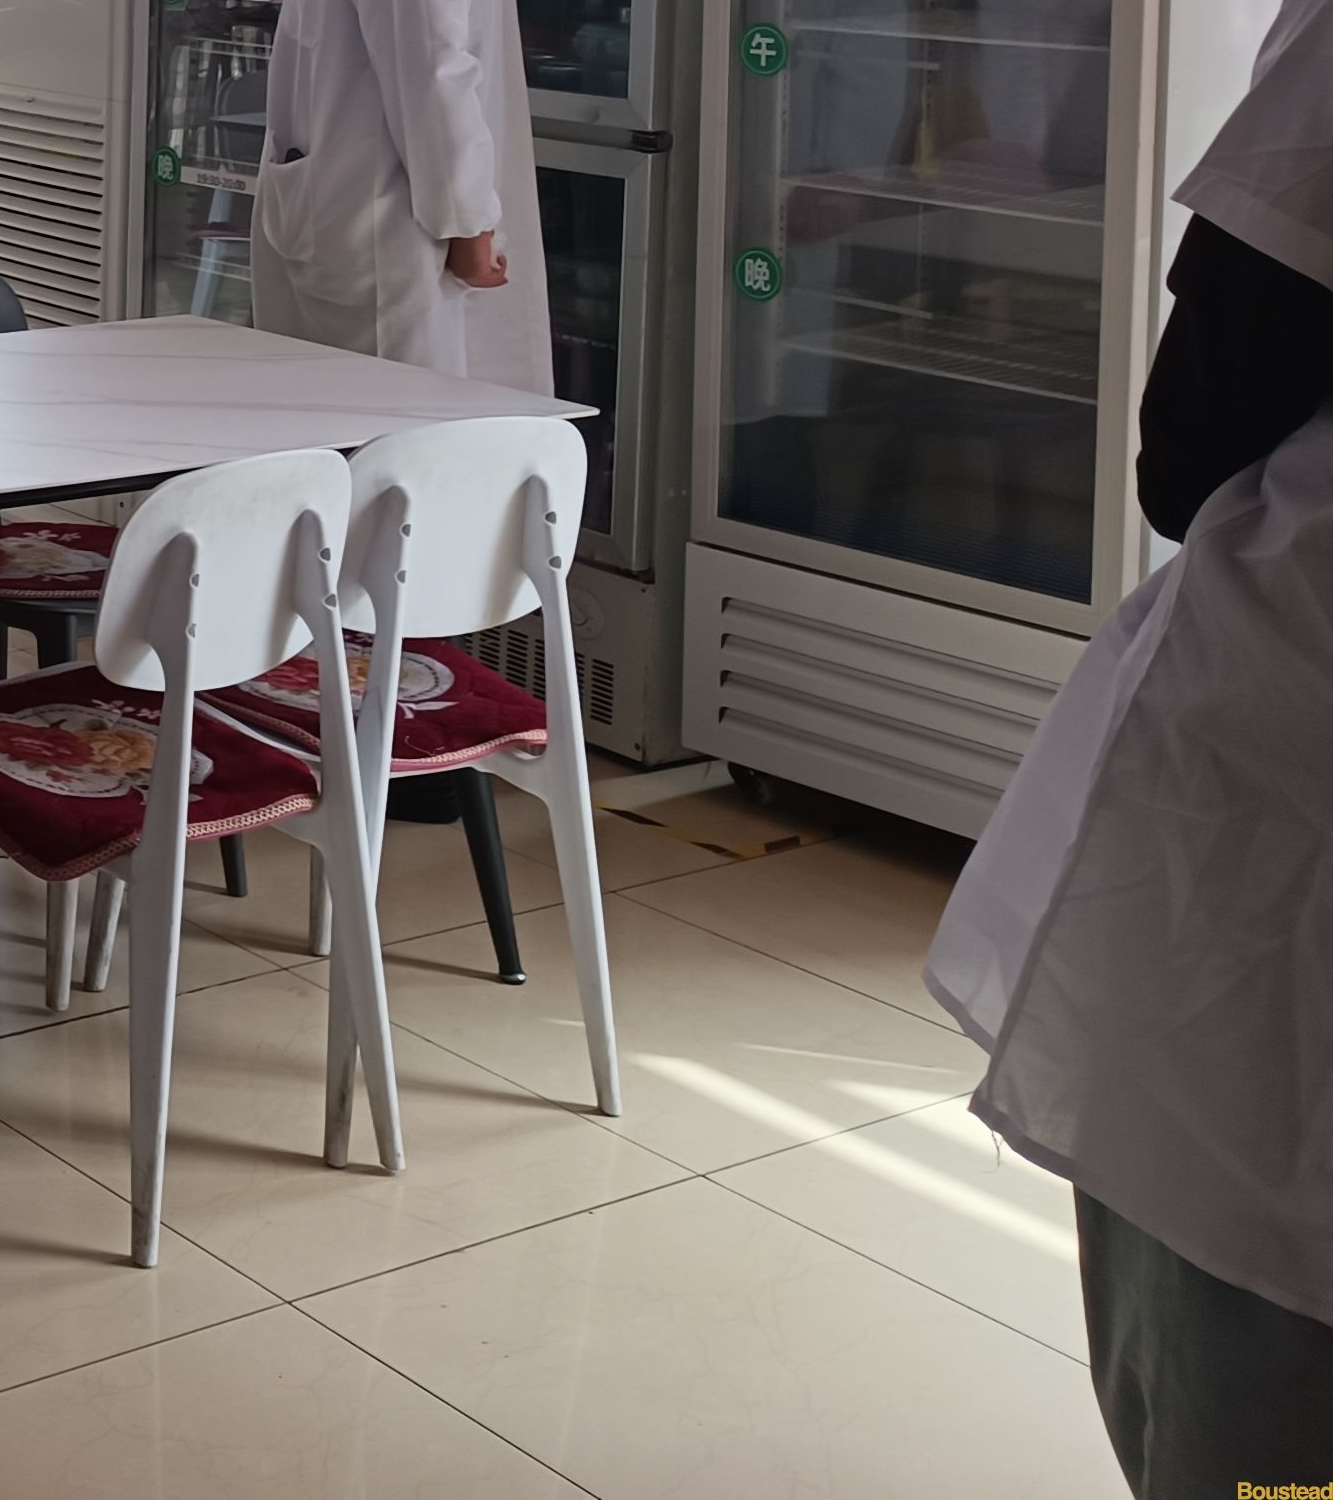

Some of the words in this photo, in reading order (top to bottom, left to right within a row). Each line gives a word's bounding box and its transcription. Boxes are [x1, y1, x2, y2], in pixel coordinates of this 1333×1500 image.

[749, 32, 778, 68] 午
[157, 154, 174, 181] 晚
[744, 258, 772, 291] 晚
